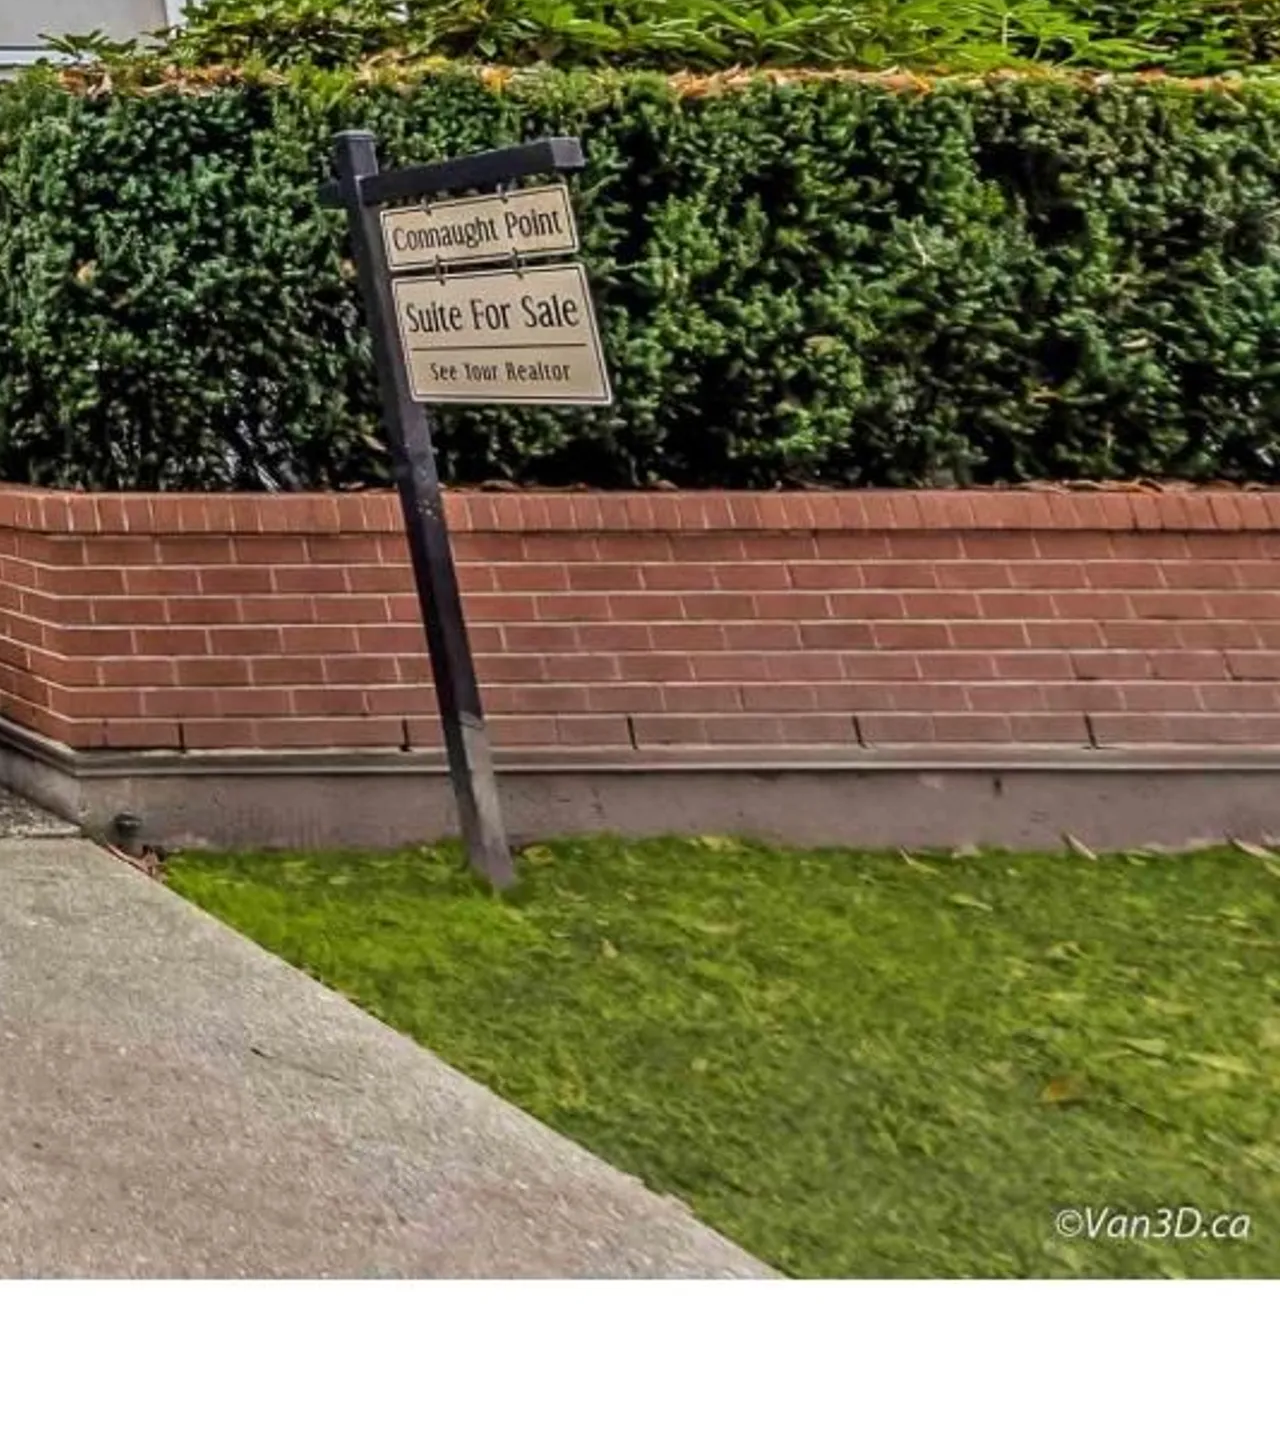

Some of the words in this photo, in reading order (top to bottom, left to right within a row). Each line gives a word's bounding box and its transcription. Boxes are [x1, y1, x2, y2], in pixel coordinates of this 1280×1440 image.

[392, 215, 498, 251] Connaught
[505, 208, 564, 239] Point
[406, 301, 463, 333] Suite
[470, 297, 511, 330] For
[524, 294, 581, 328] Sale
[429, 362, 458, 381] See
[463, 362, 498, 381] Your
[505, 361, 571, 382] Realtor
